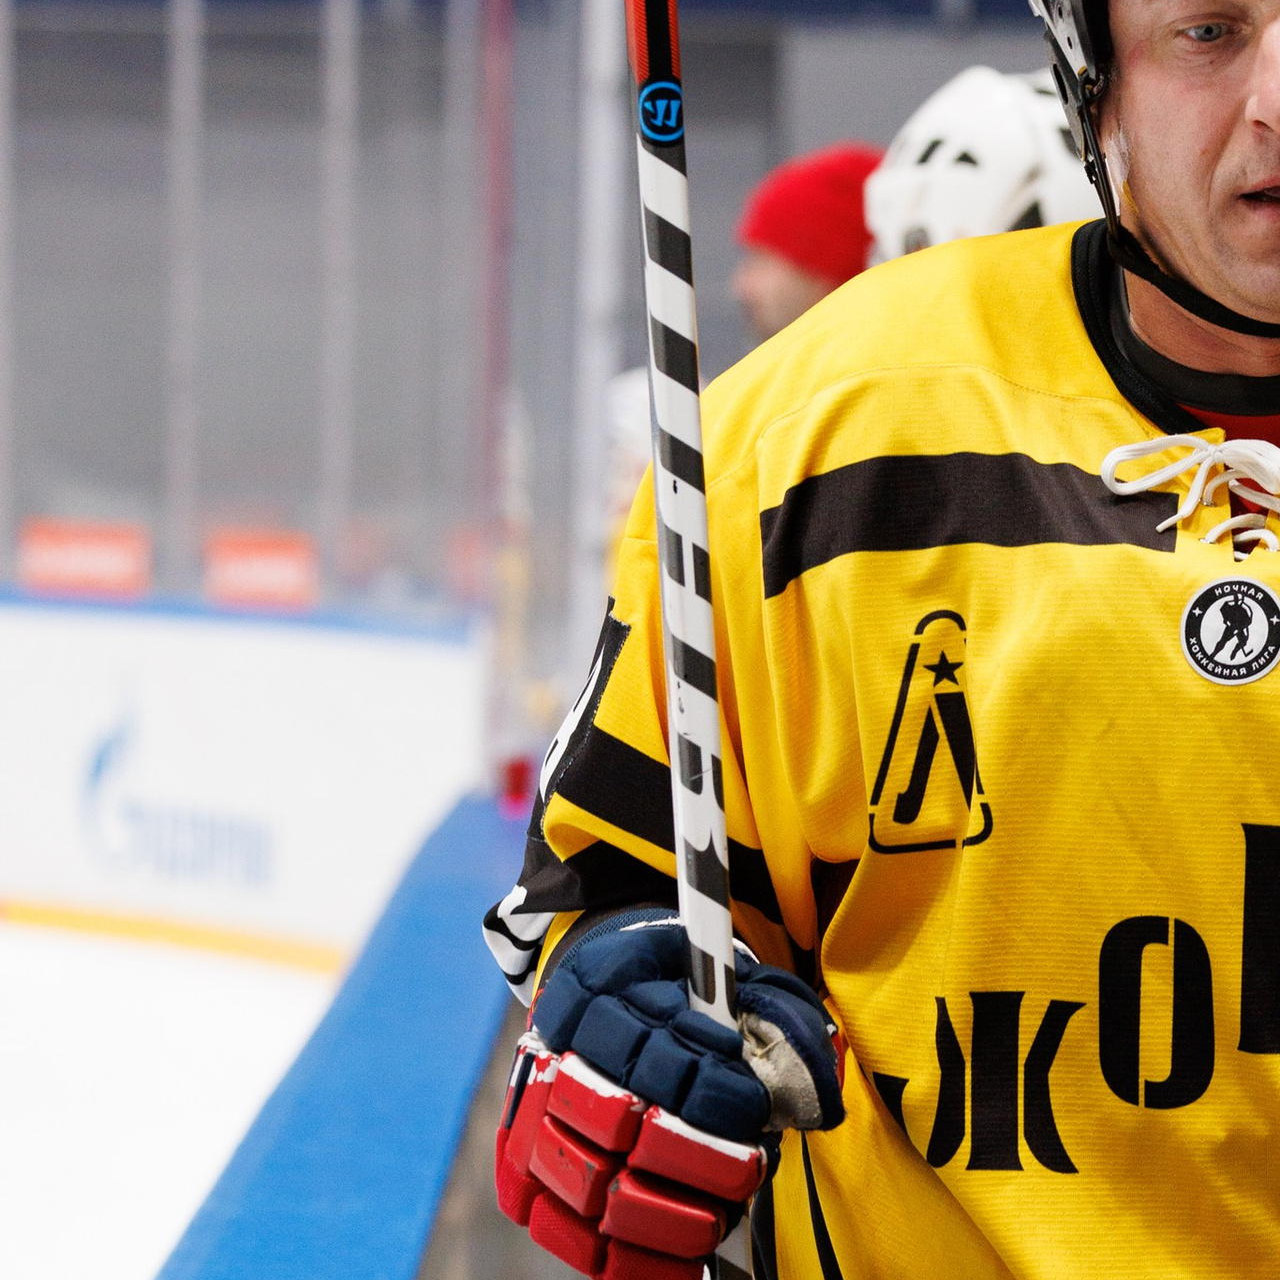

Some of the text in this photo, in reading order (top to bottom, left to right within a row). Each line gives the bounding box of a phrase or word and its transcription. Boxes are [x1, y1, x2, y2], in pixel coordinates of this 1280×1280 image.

[1214, 584, 1264, 601] НОЧНАЯ
[1189, 637, 1277, 677] ХОККЕЙНАЯ ЛИГА
